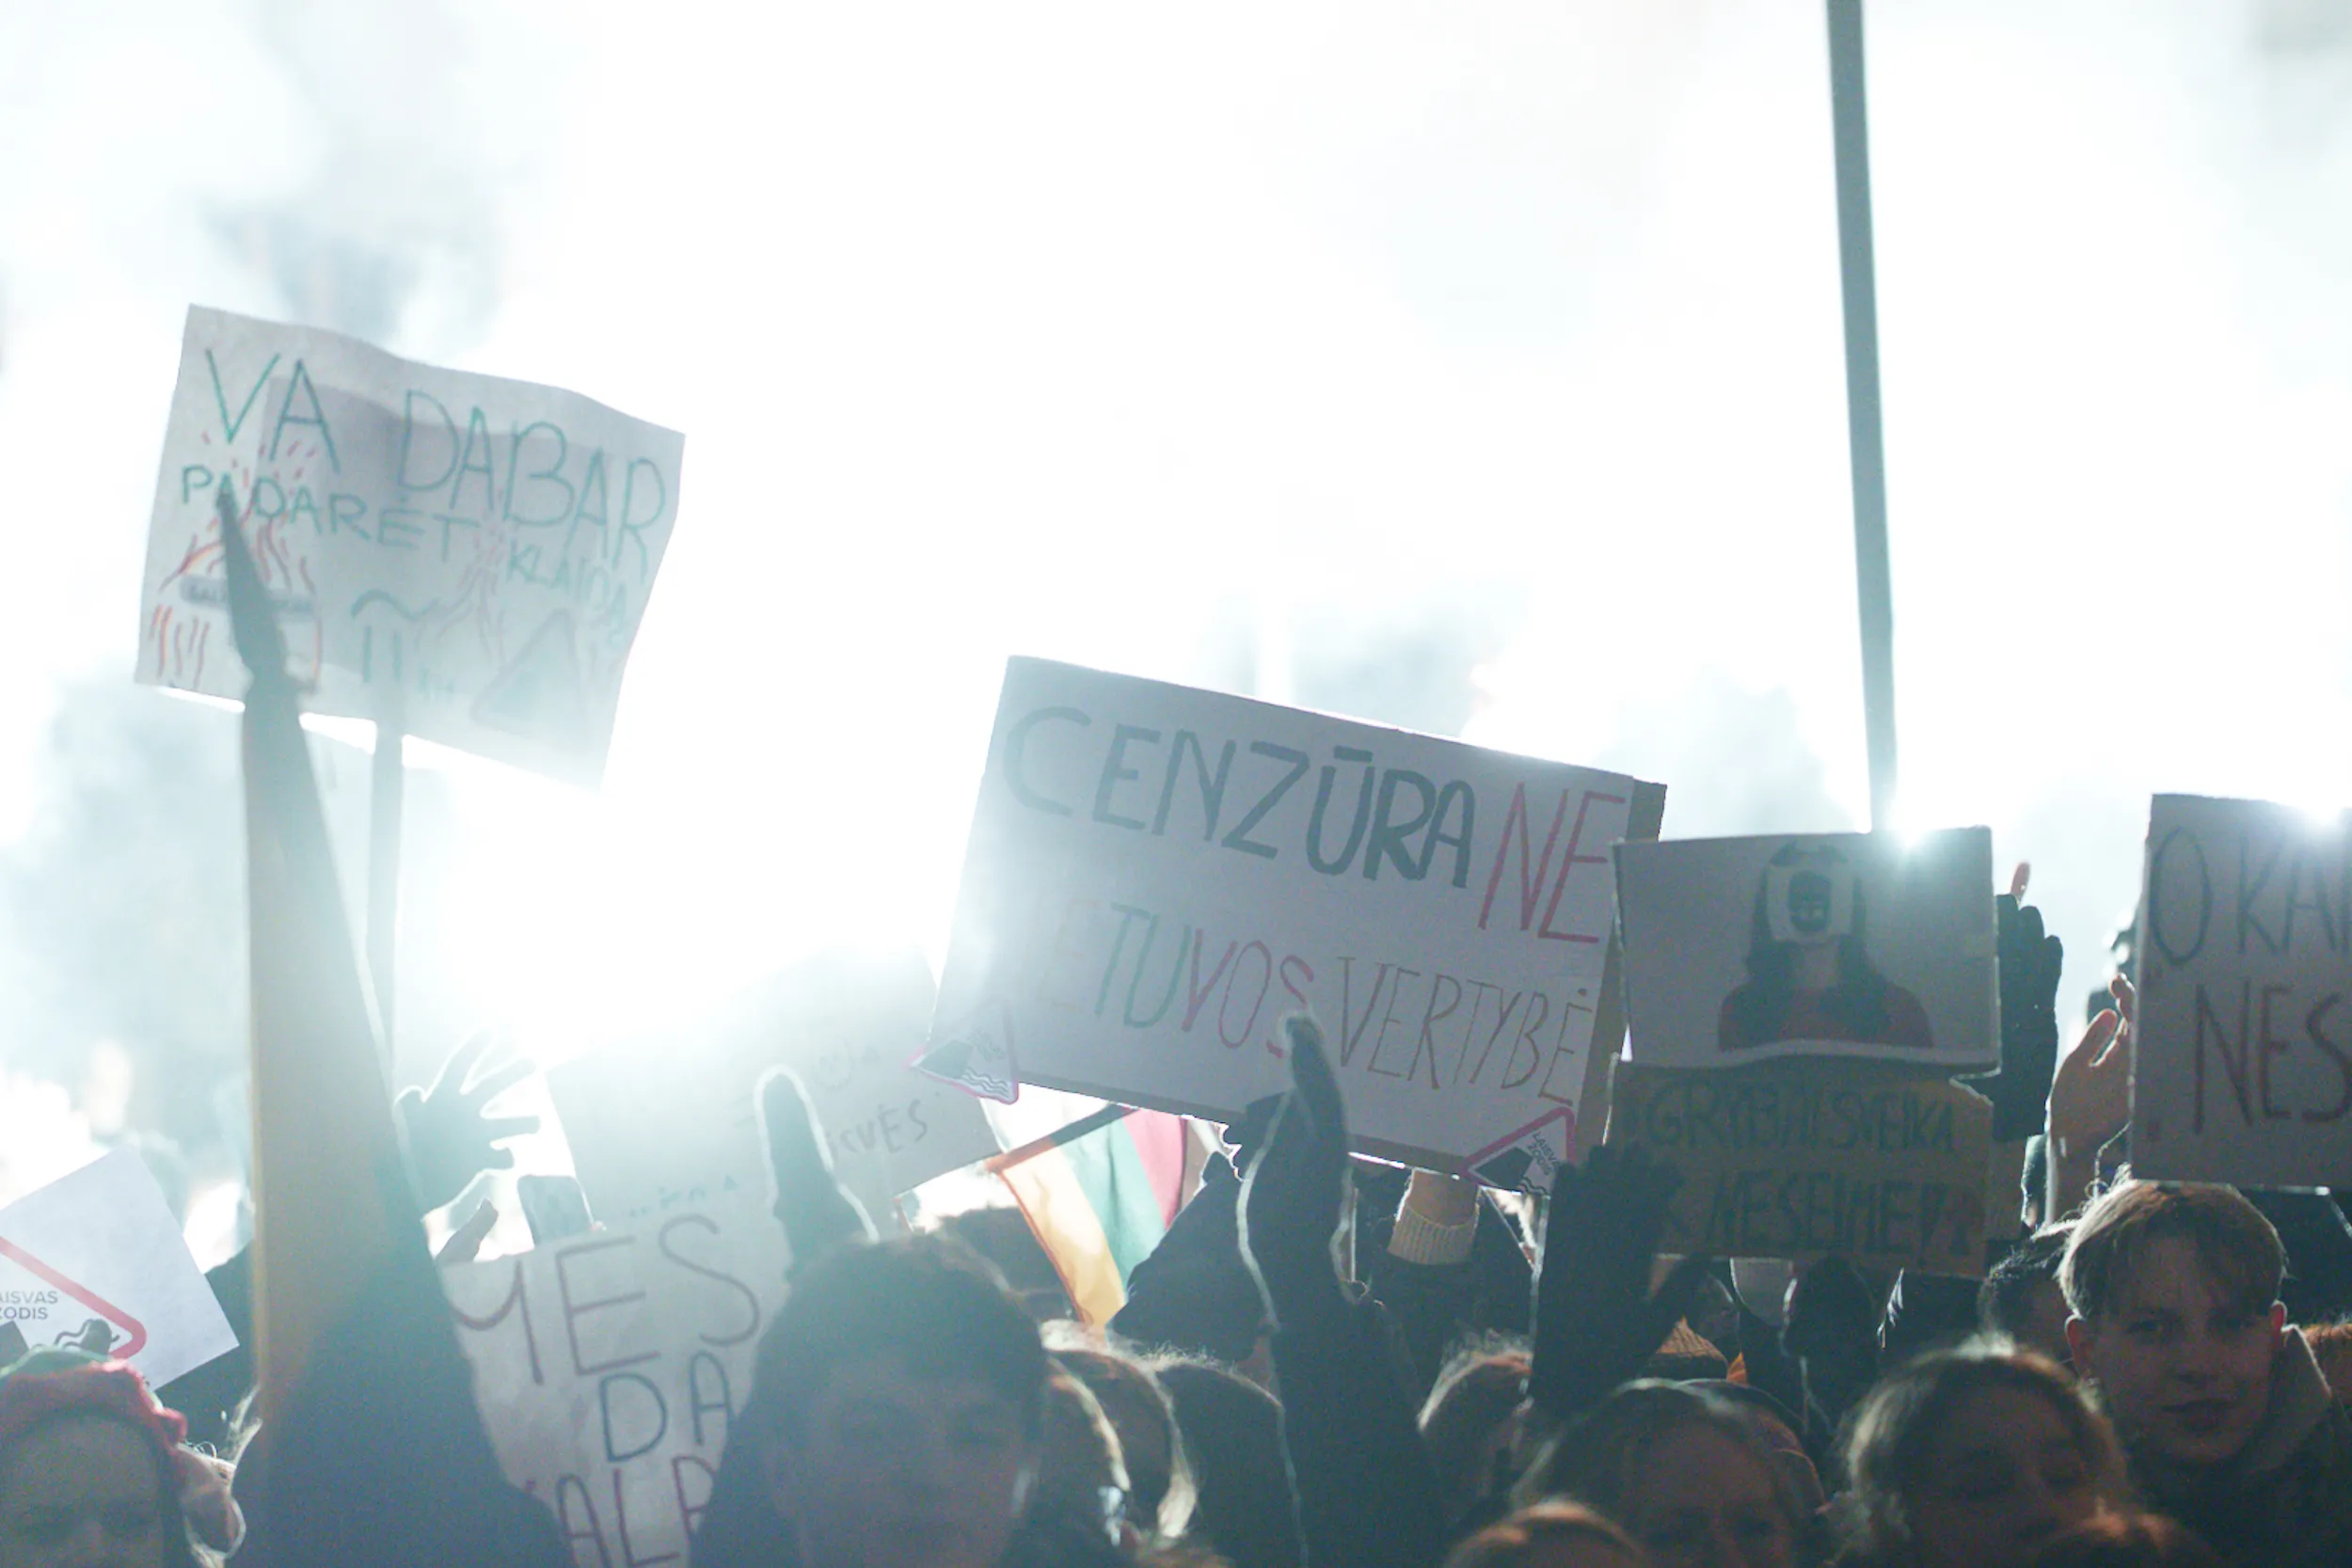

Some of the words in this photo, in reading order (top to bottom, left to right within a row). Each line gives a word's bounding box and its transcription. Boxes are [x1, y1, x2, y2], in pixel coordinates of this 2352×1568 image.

[204, 348, 342, 476] VA
[397, 388, 667, 586] DABAR
[1003, 704, 1478, 890] CENZŪRA
[1476, 781, 1627, 945] NE
[1335, 954, 1596, 1108] VERTYBĖ
[0, 1306, 49, 1321] ODIS
